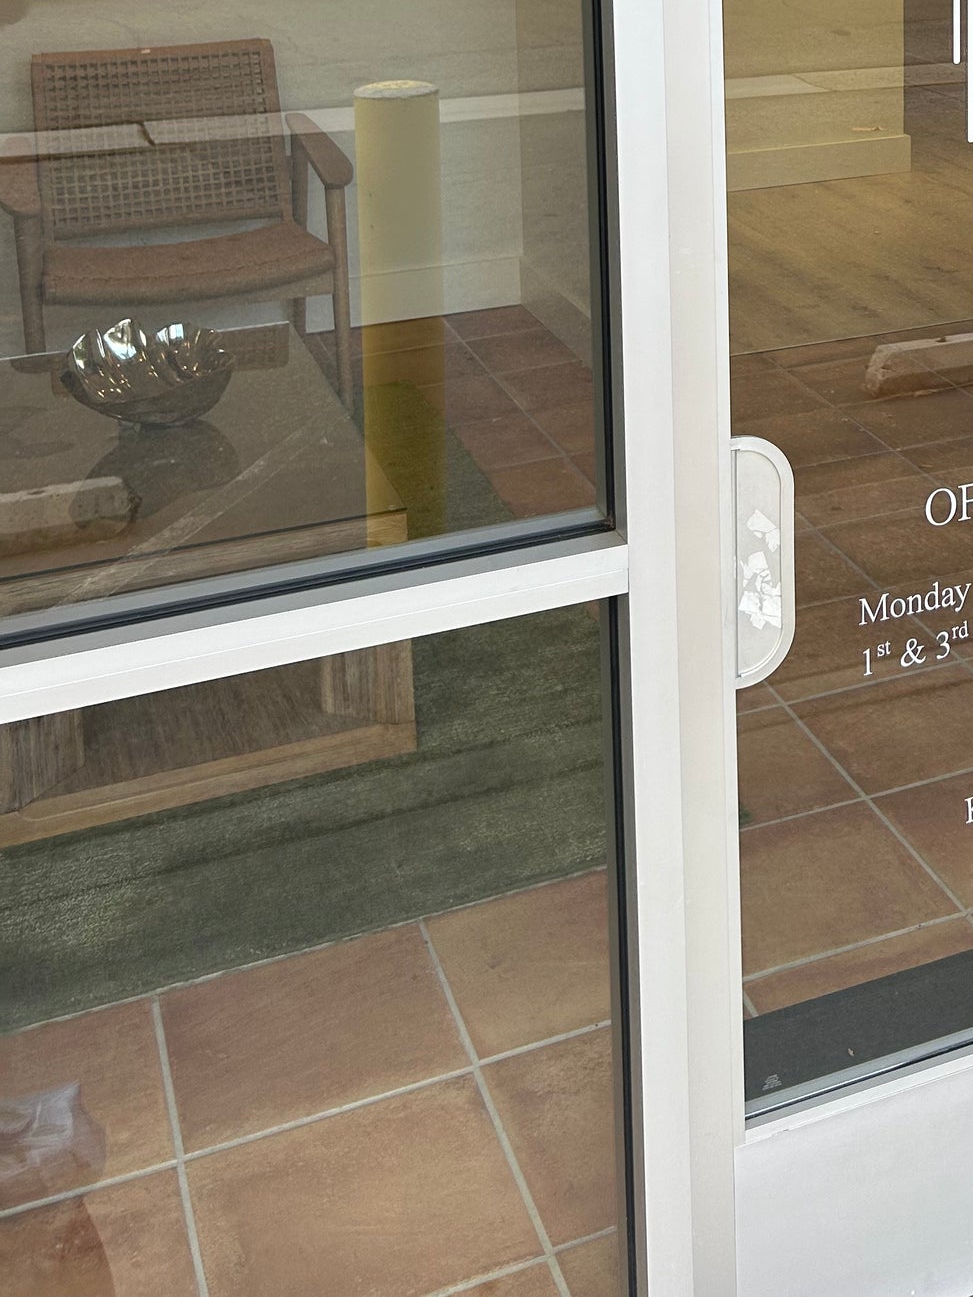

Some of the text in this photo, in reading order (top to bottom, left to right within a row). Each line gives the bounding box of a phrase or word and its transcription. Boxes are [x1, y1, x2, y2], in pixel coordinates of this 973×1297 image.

[858, 582, 972, 626] Monday
[862, 640, 891, 677] 1st
[900, 638, 927, 668] &
[935, 620, 970, 660] 3rd
